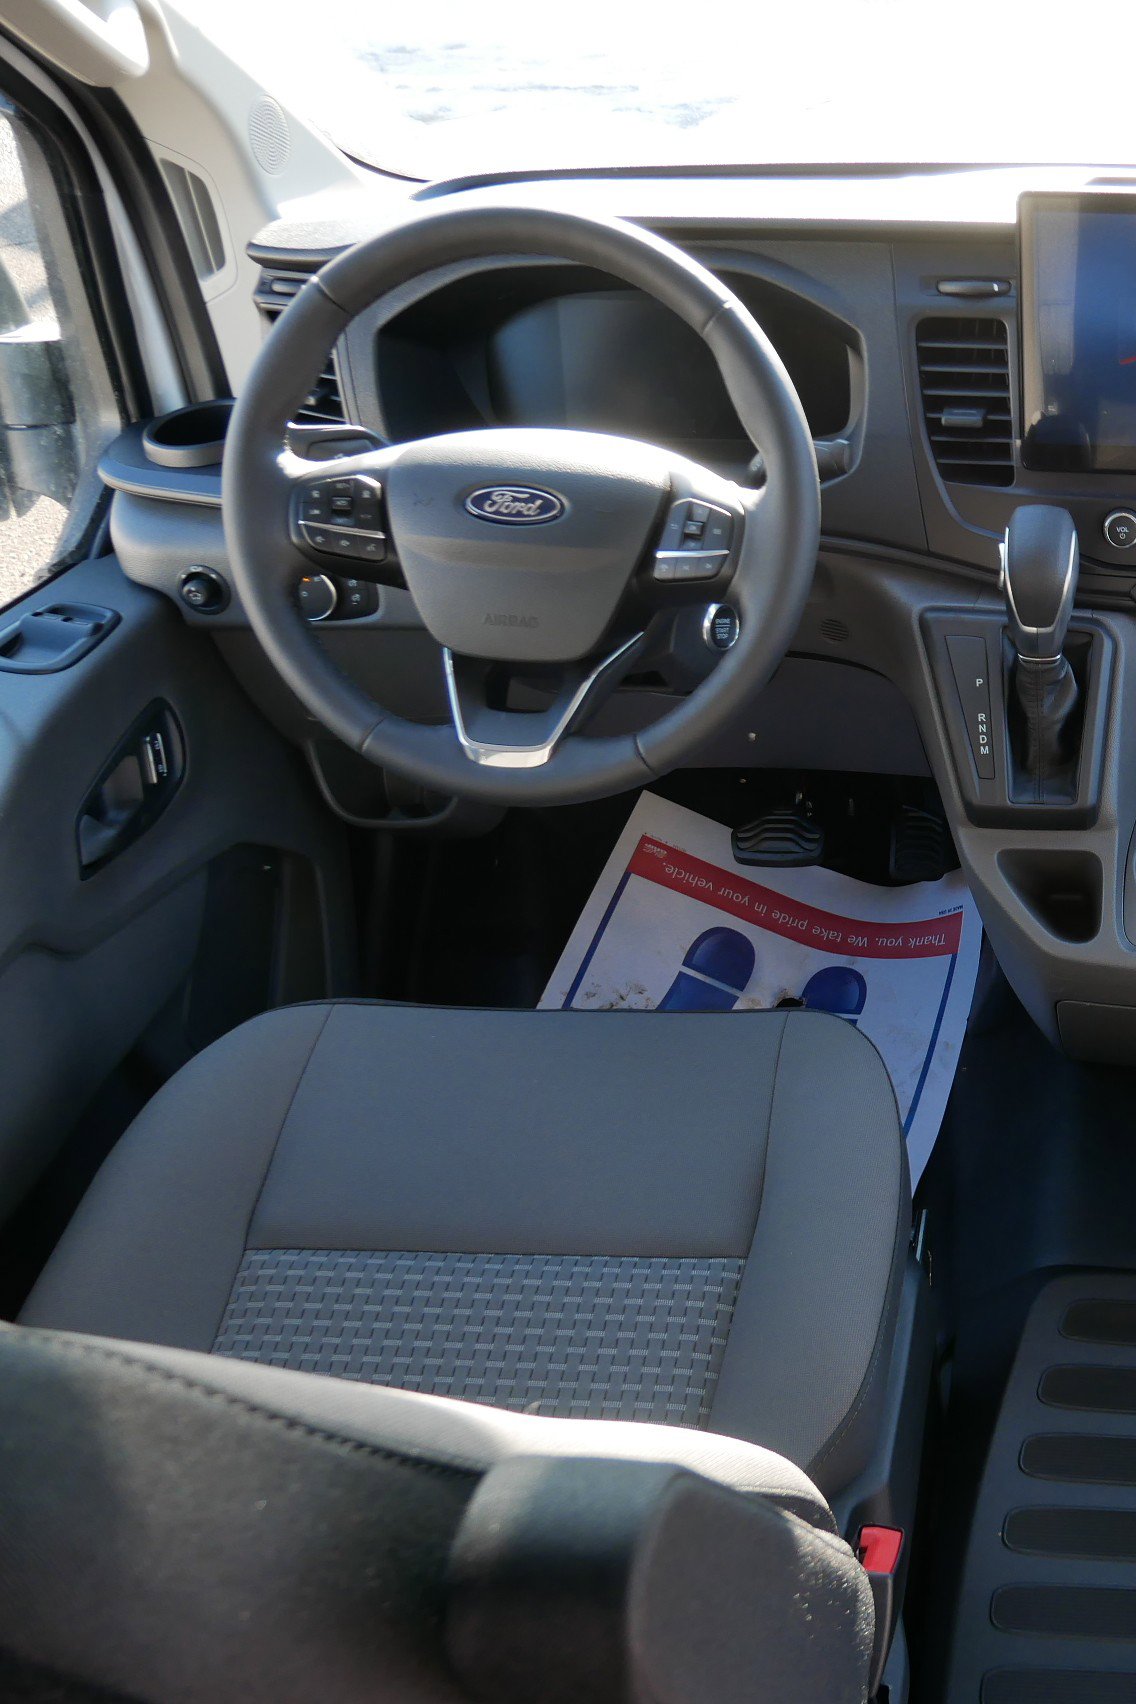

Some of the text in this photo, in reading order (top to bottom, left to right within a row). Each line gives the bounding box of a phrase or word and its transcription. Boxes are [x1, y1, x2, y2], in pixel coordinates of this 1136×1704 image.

[483, 490, 543, 516] Ford
[483, 613, 539, 629] AIRBAG
[975, 678, 984, 687] P
[977, 713, 987, 722] R
[978, 723, 987, 733] N
[979, 735, 988, 744] D
[980, 745, 989, 755] M
[661, 862, 946, 949] Thank you. We take pride in your vehicle.
